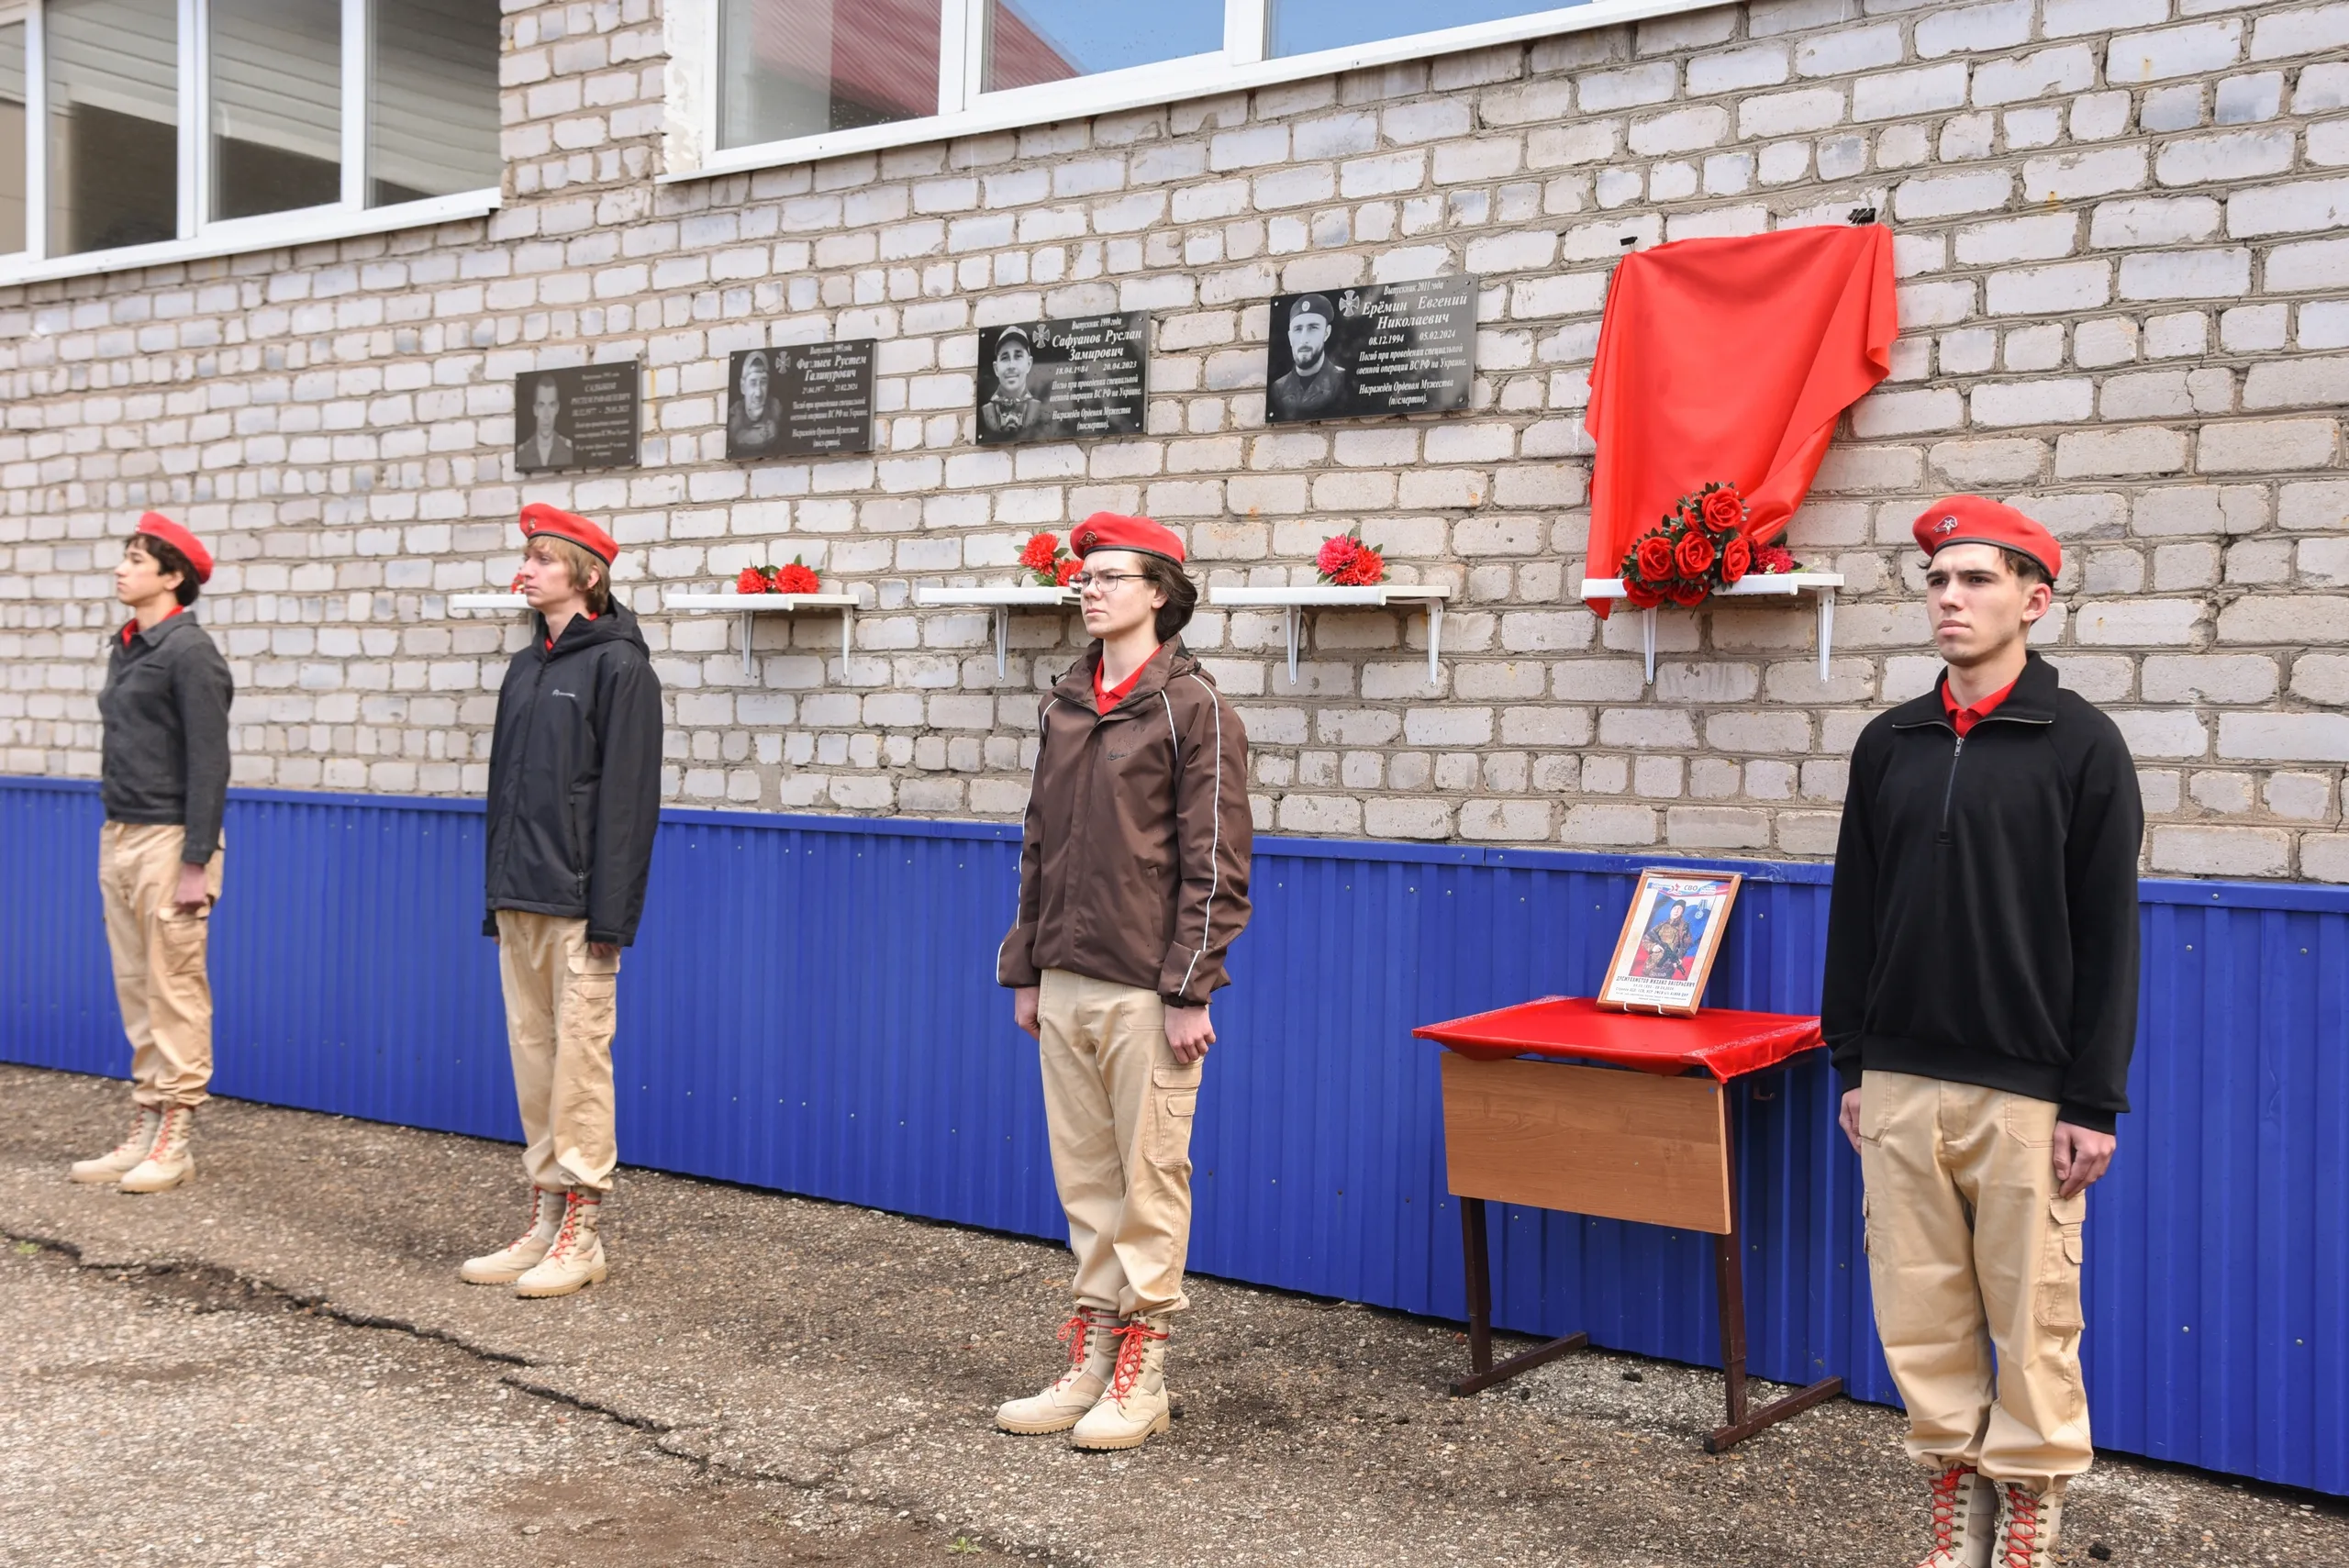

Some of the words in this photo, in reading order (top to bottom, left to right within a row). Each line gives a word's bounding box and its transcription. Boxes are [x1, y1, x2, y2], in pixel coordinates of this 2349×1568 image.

[1384, 285, 1417, 296] Выпускник
[1418, 282, 1430, 291] 2011
[1362, 301, 1408, 317] Ерёмин
[1417, 292, 1467, 309] Евгений
[1376, 313, 1450, 329] Николаевич
[1052, 334, 1101, 349] Сафуанов
[1105, 329, 1141, 344] Руслан
[1369, 334, 1405, 346] 08.12.1994
[1419, 329, 1456, 340] 05.02.2024
[1069, 348, 1124, 361] Замирович
[1378, 352, 1389, 362] при
[1390, 349, 1424, 361] проведении
[1425, 343, 1464, 357] специальной
[834, 355, 866, 368] Рустем
[1380, 364, 1408, 375] операции
[1409, 360, 1419, 371] ВС
[1420, 360, 1430, 369] РФ
[1094, 390, 1102, 398] ВС
[1103, 388, 1111, 397] РФ
[1393, 381, 1419, 394] Орденом
[1420, 379, 1453, 391] Мужества
